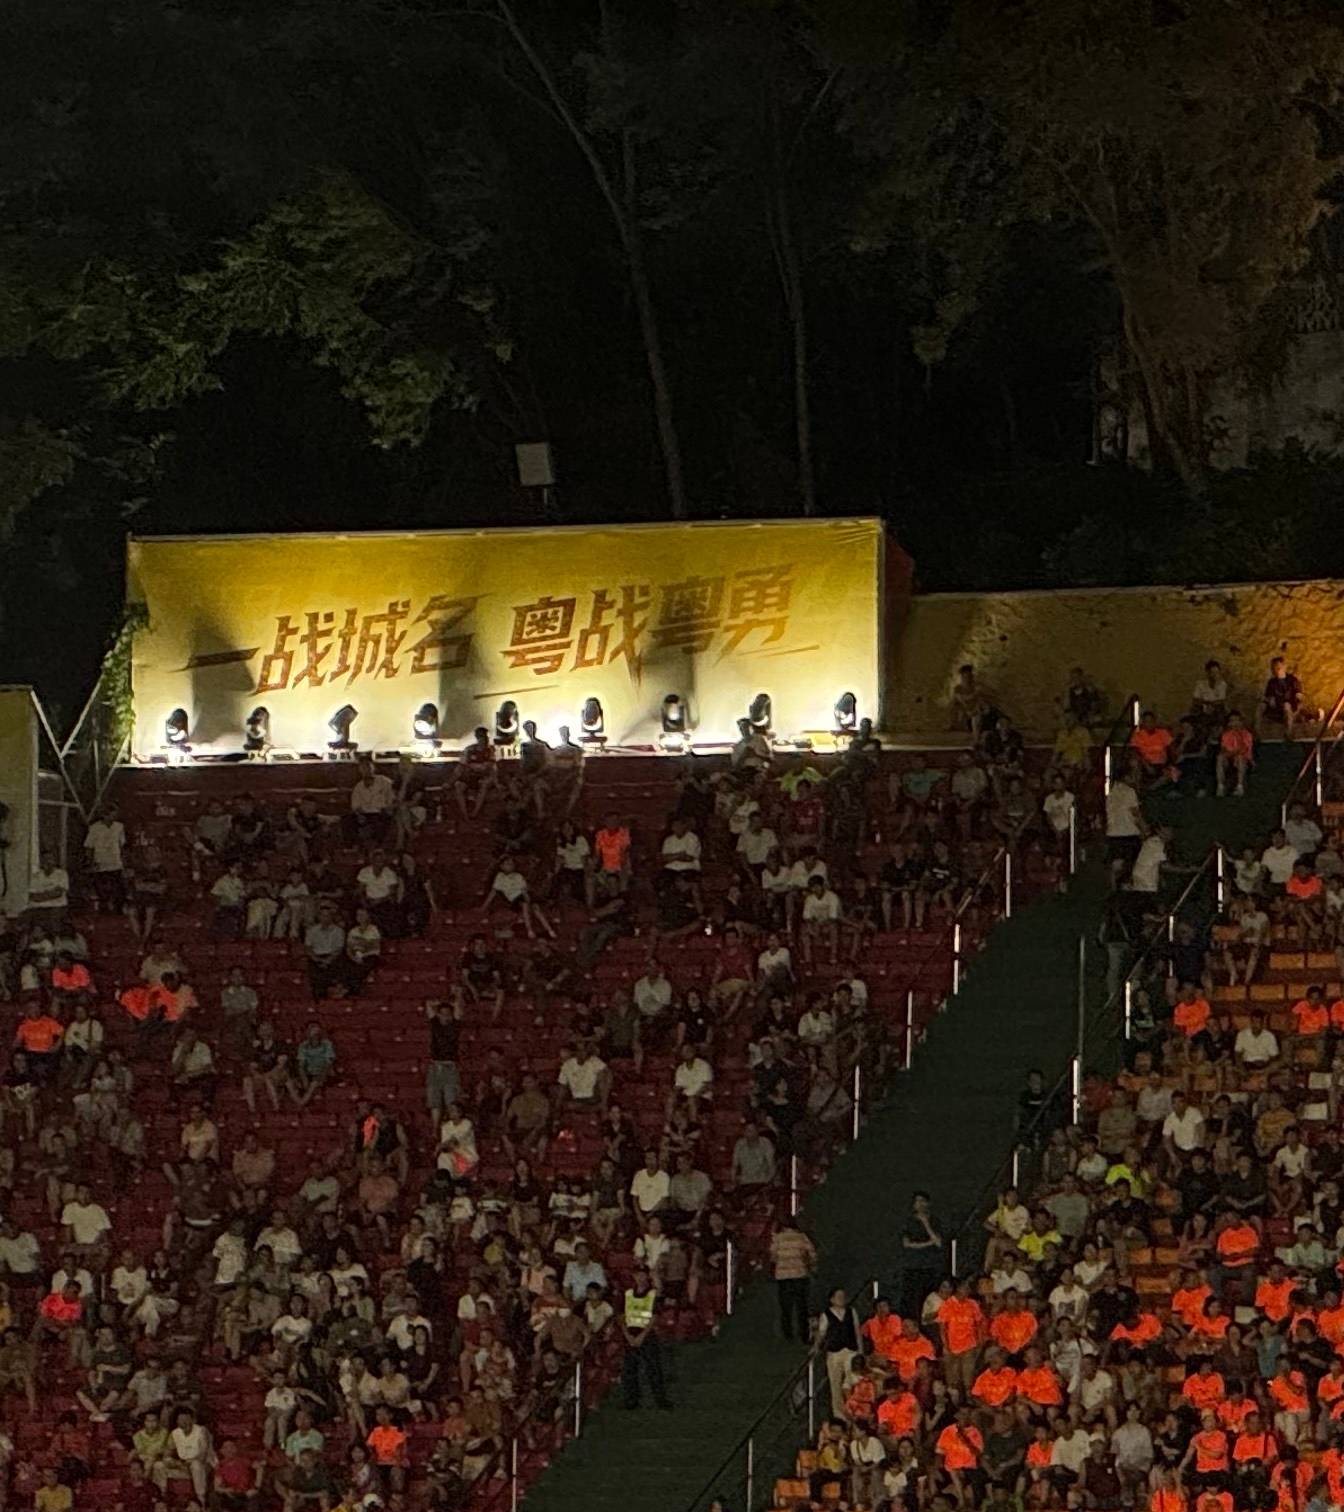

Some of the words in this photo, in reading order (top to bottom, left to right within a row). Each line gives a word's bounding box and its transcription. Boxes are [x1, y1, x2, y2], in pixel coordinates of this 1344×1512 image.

[168, 592, 493, 697] 一战城名
[500, 562, 798, 684] 粤战粤勇
